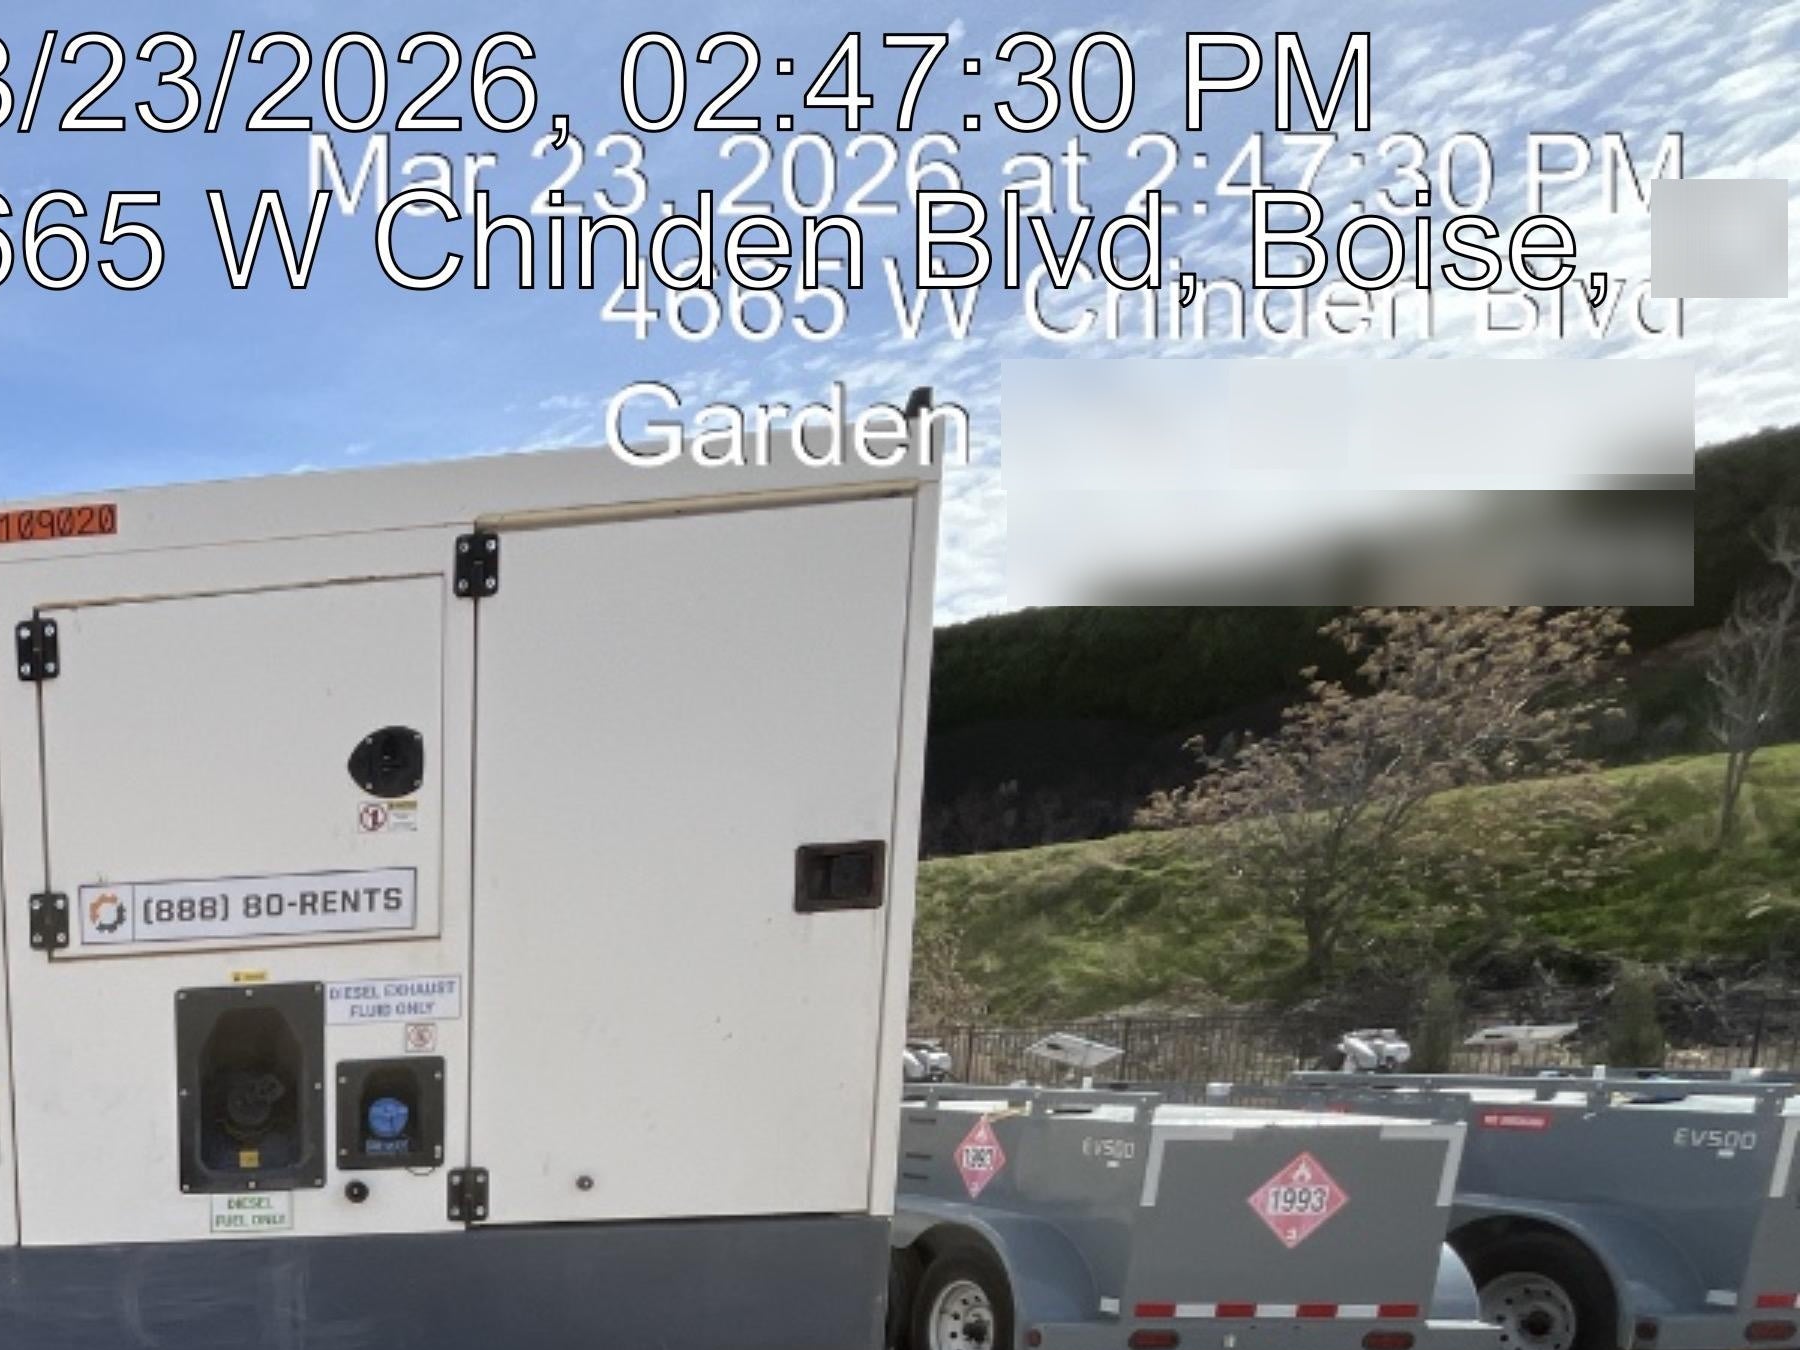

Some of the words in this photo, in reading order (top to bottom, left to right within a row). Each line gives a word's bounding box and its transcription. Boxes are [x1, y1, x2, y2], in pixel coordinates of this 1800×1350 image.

[0, 504, 114, 541] 109020
[143, 893, 229, 923] (888)
[242, 887, 403, 917] 80-RENTS
[1674, 1127, 1756, 1150] EV500
[1271, 1187, 1327, 1212] 1993
